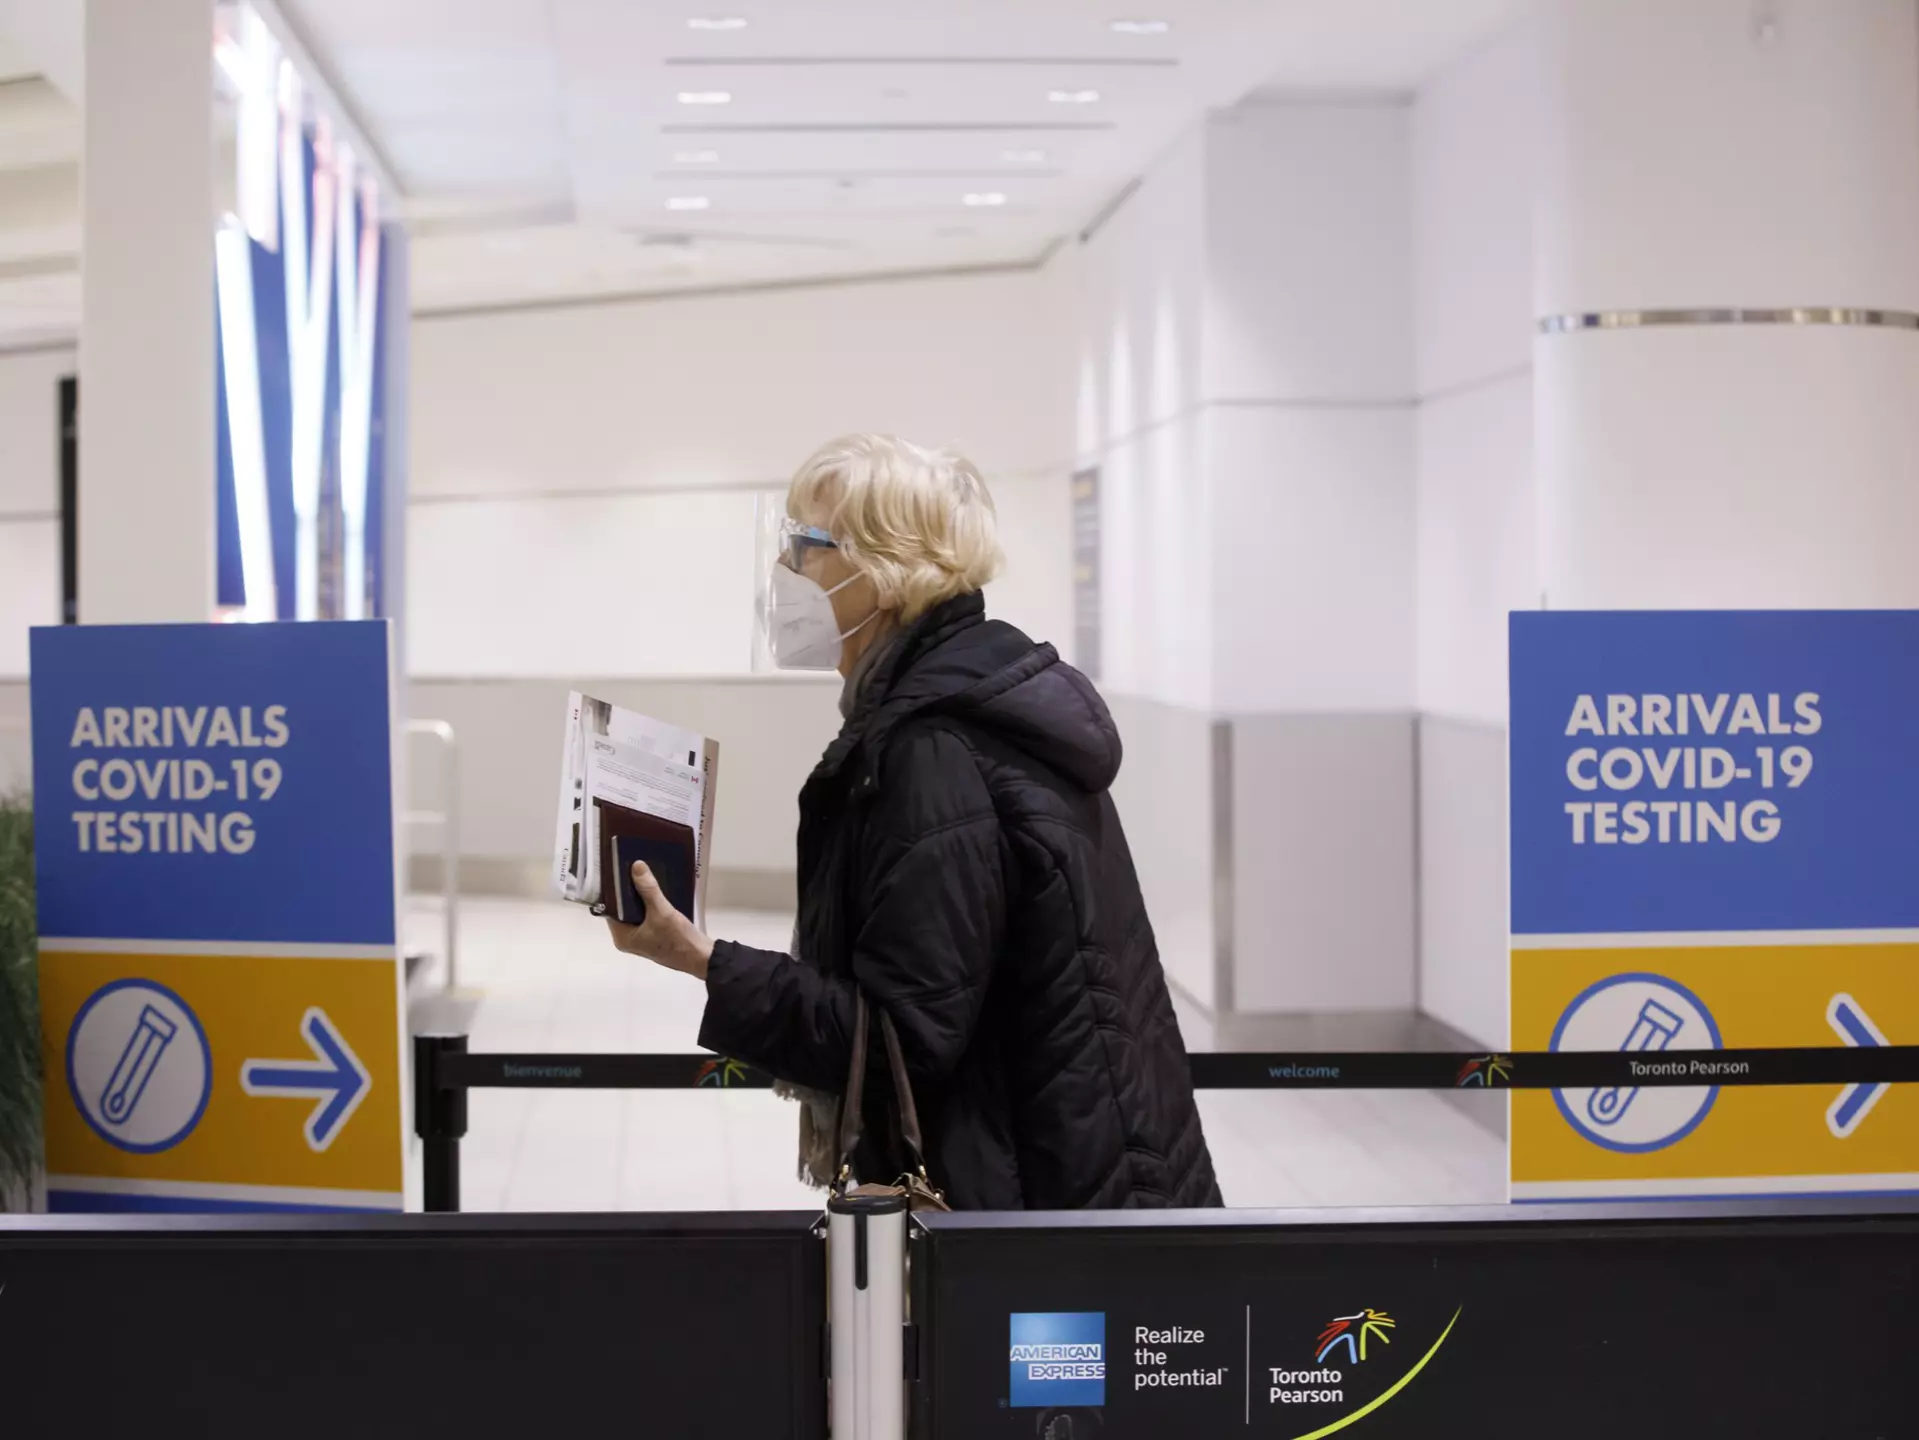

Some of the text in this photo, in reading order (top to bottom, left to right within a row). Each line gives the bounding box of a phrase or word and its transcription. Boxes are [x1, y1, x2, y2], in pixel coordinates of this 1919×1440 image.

[1565, 692, 1822, 736] ARRIVALS
[70, 705, 290, 748] ARRIVALS
[1566, 746, 1814, 791] COVID-19
[72, 759, 283, 800] COVID-19
[1564, 800, 1782, 844] TESTING
[72, 811, 256, 853] TESTING
[503, 1062, 582, 1078] bienvenue
[1268, 1062, 1340, 1078] welcome
[1629, 1059, 1750, 1076] Toronto Pearson
[1134, 1326, 1205, 1344] Realize
[1010, 1345, 1100, 1360] AMERICAN
[1134, 1348, 1168, 1365] the
[1030, 1364, 1105, 1379] EXPRESS
[1268, 1367, 1342, 1384] Toronto
[1269, 1387, 1344, 1403] Pearson
